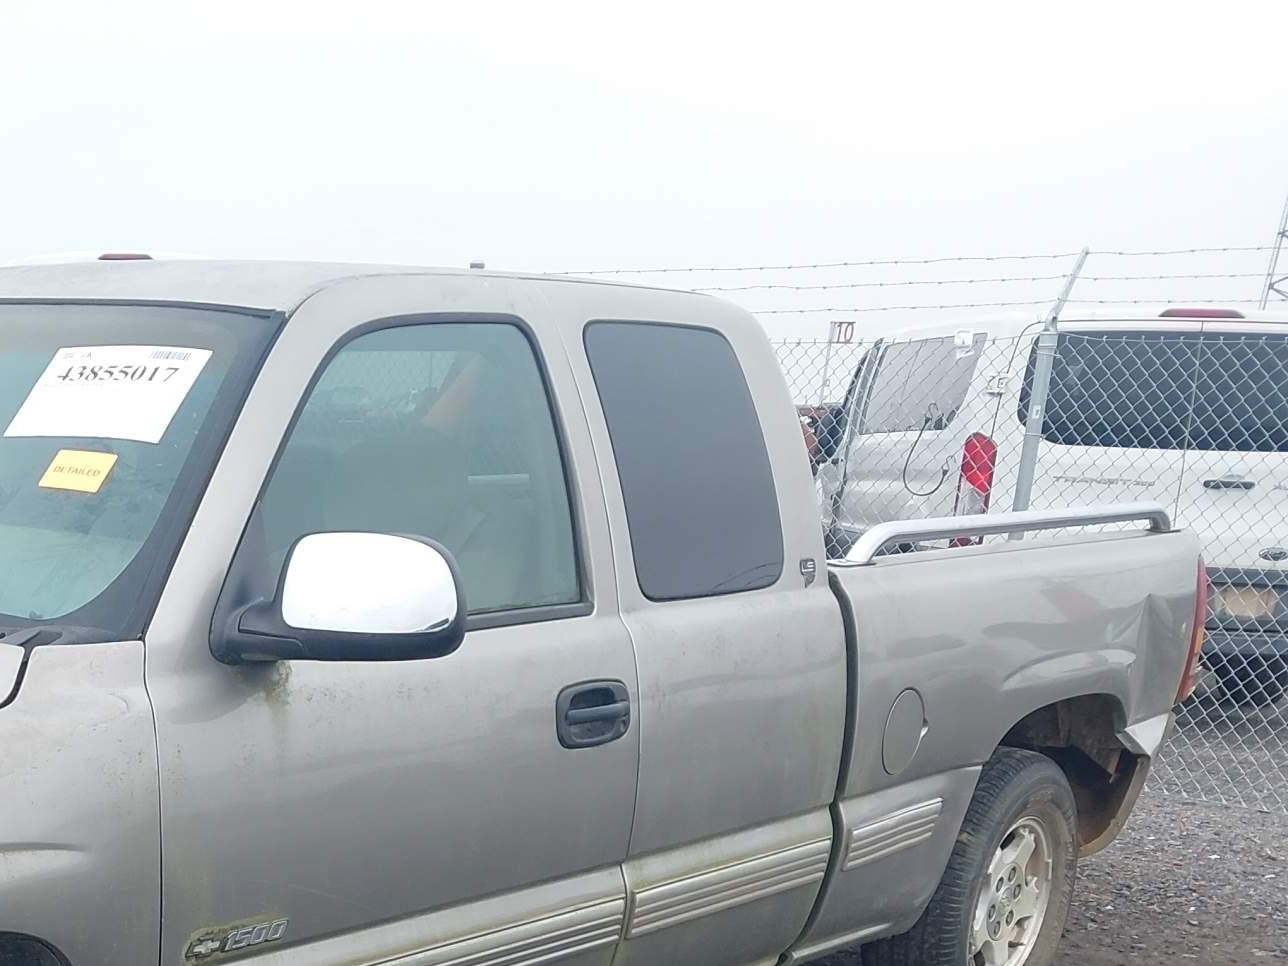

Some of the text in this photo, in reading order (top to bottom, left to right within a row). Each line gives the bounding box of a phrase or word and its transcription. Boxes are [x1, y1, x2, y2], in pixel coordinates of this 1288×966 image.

[57, 365, 180, 383] 43855017
[52, 465, 101, 477] DETAILED
[221, 918, 288, 953] 1500
